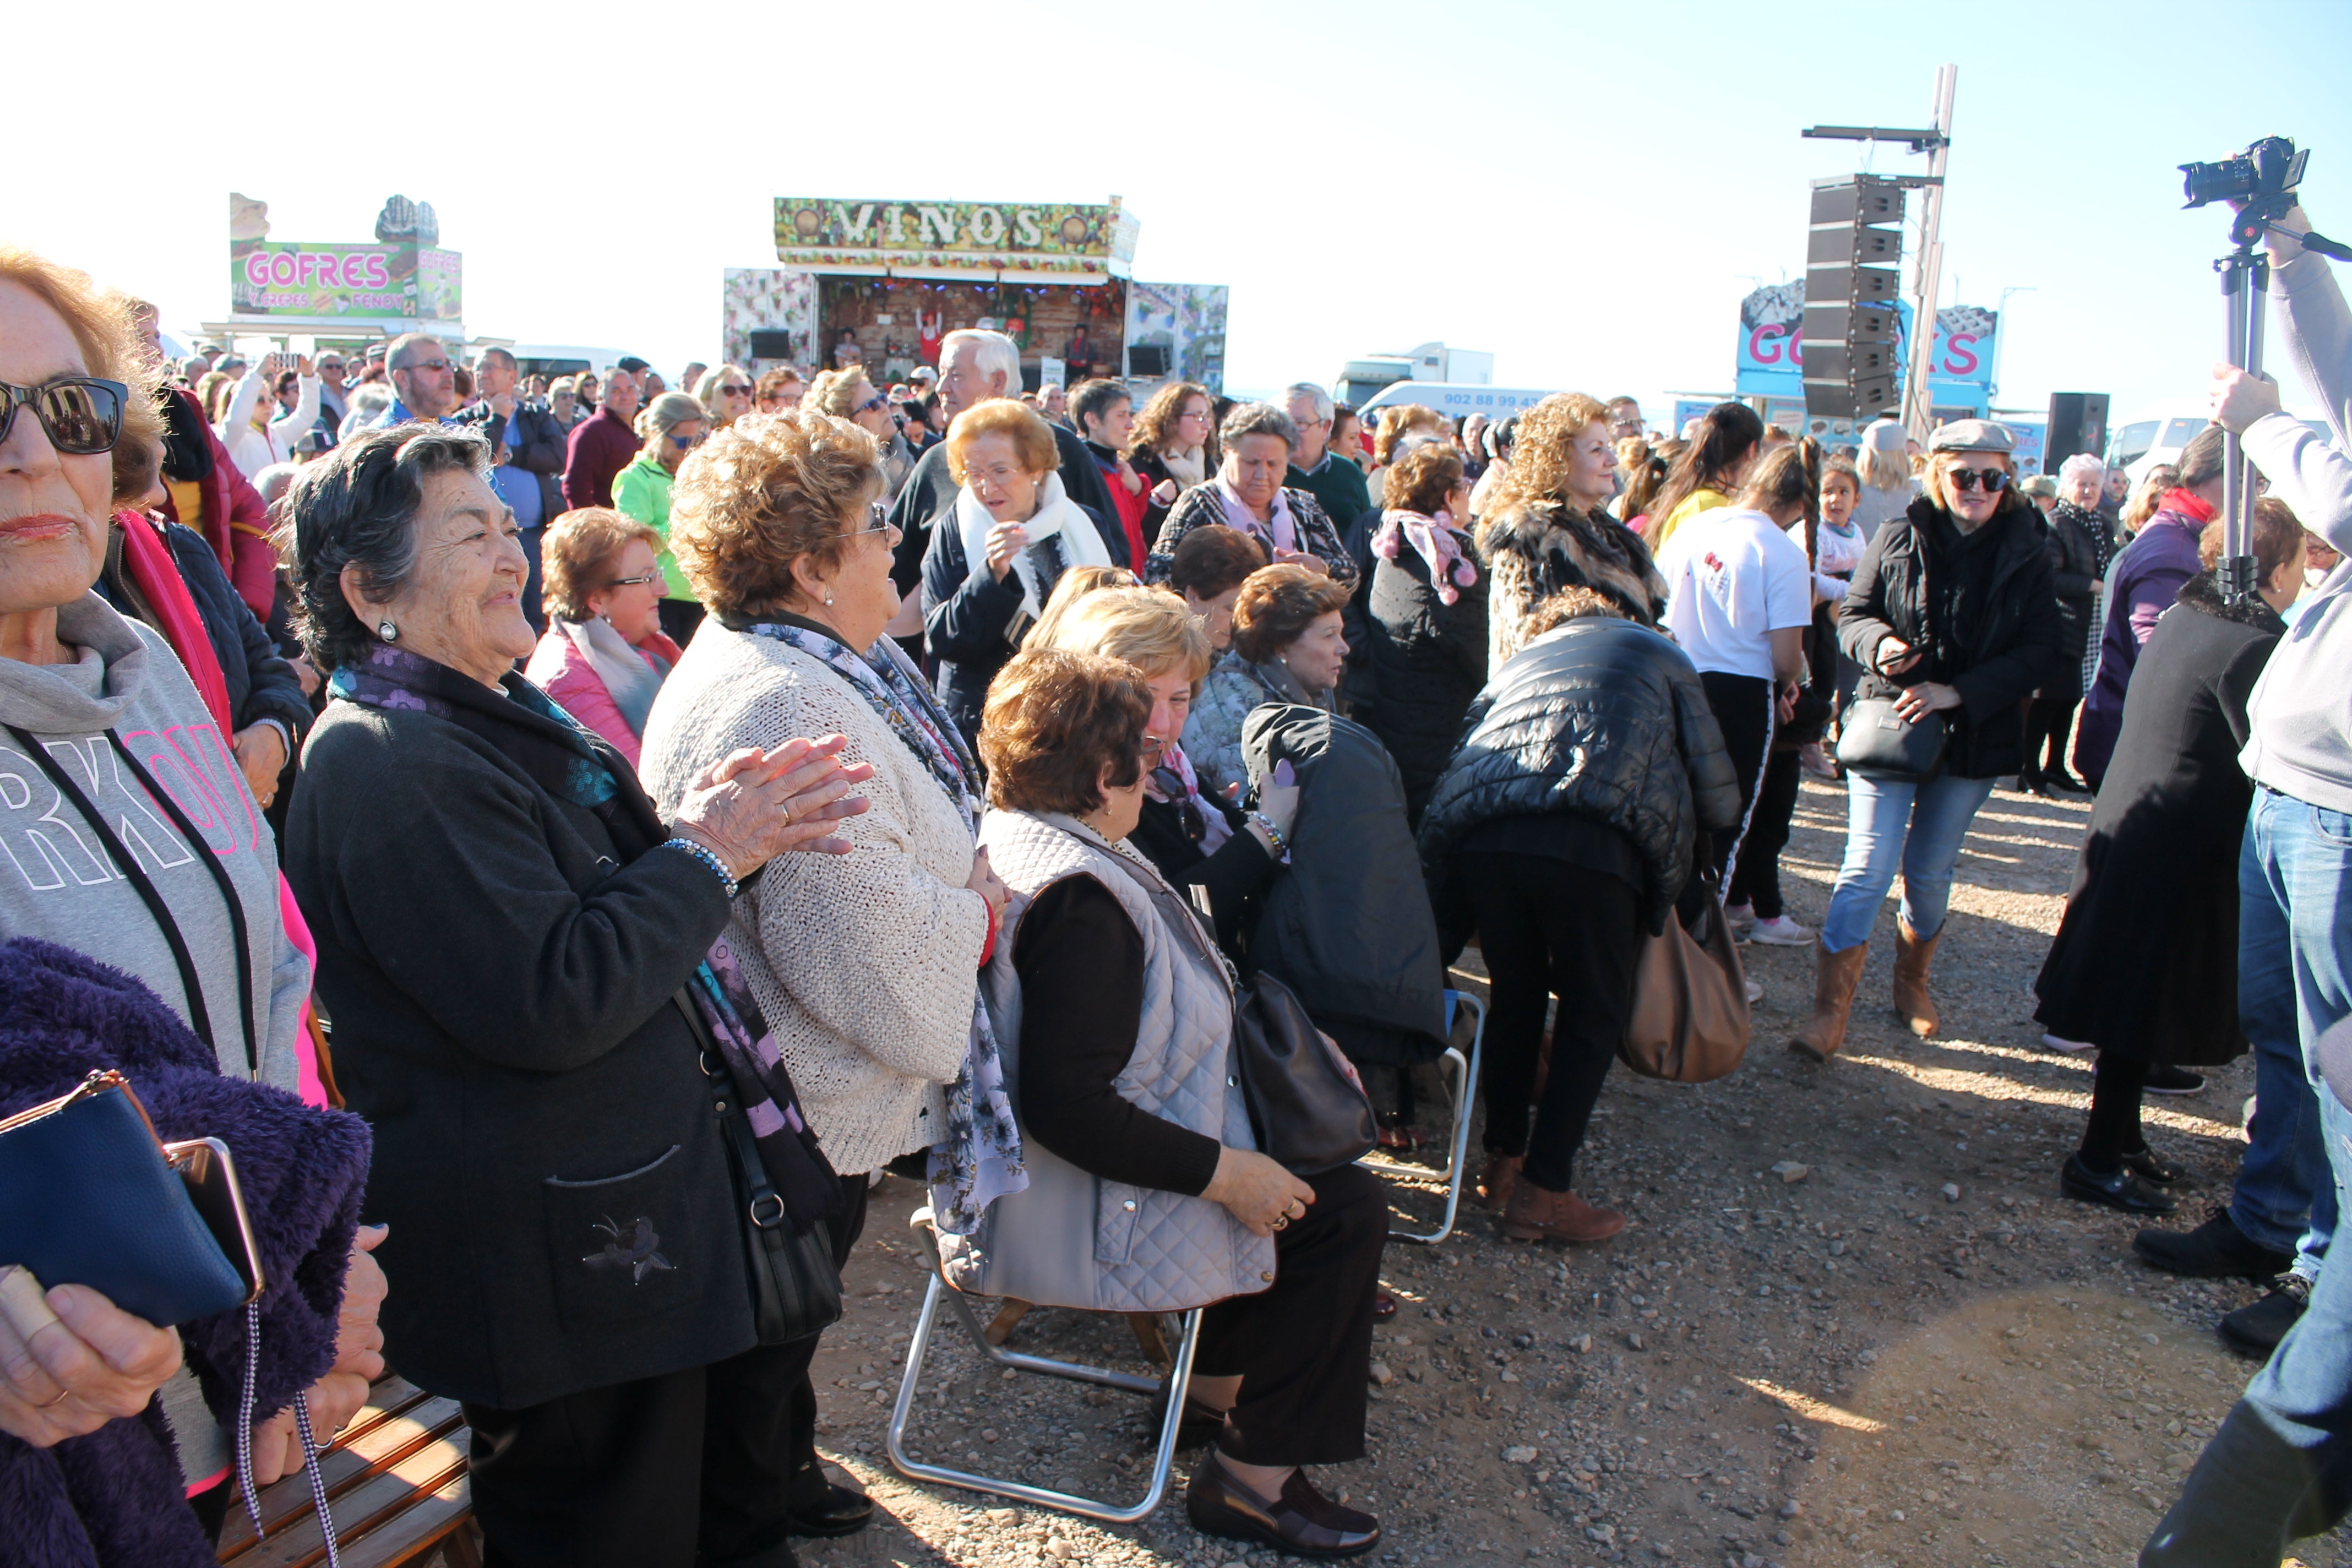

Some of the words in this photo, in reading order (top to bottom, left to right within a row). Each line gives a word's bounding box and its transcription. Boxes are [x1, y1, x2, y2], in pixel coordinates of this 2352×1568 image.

[834, 203, 1042, 247] VINOS
[245, 251, 390, 290] GOFRES
[418, 249, 459, 274] GOFRES
[249, 292, 258, 308] Y
[260, 292, 309, 308] CREPES
[352, 293, 404, 310] FENOY
[1445, 394, 1471, 405] 902
[1476, 395, 1494, 406] 88
[1499, 396, 1516, 407] 99
